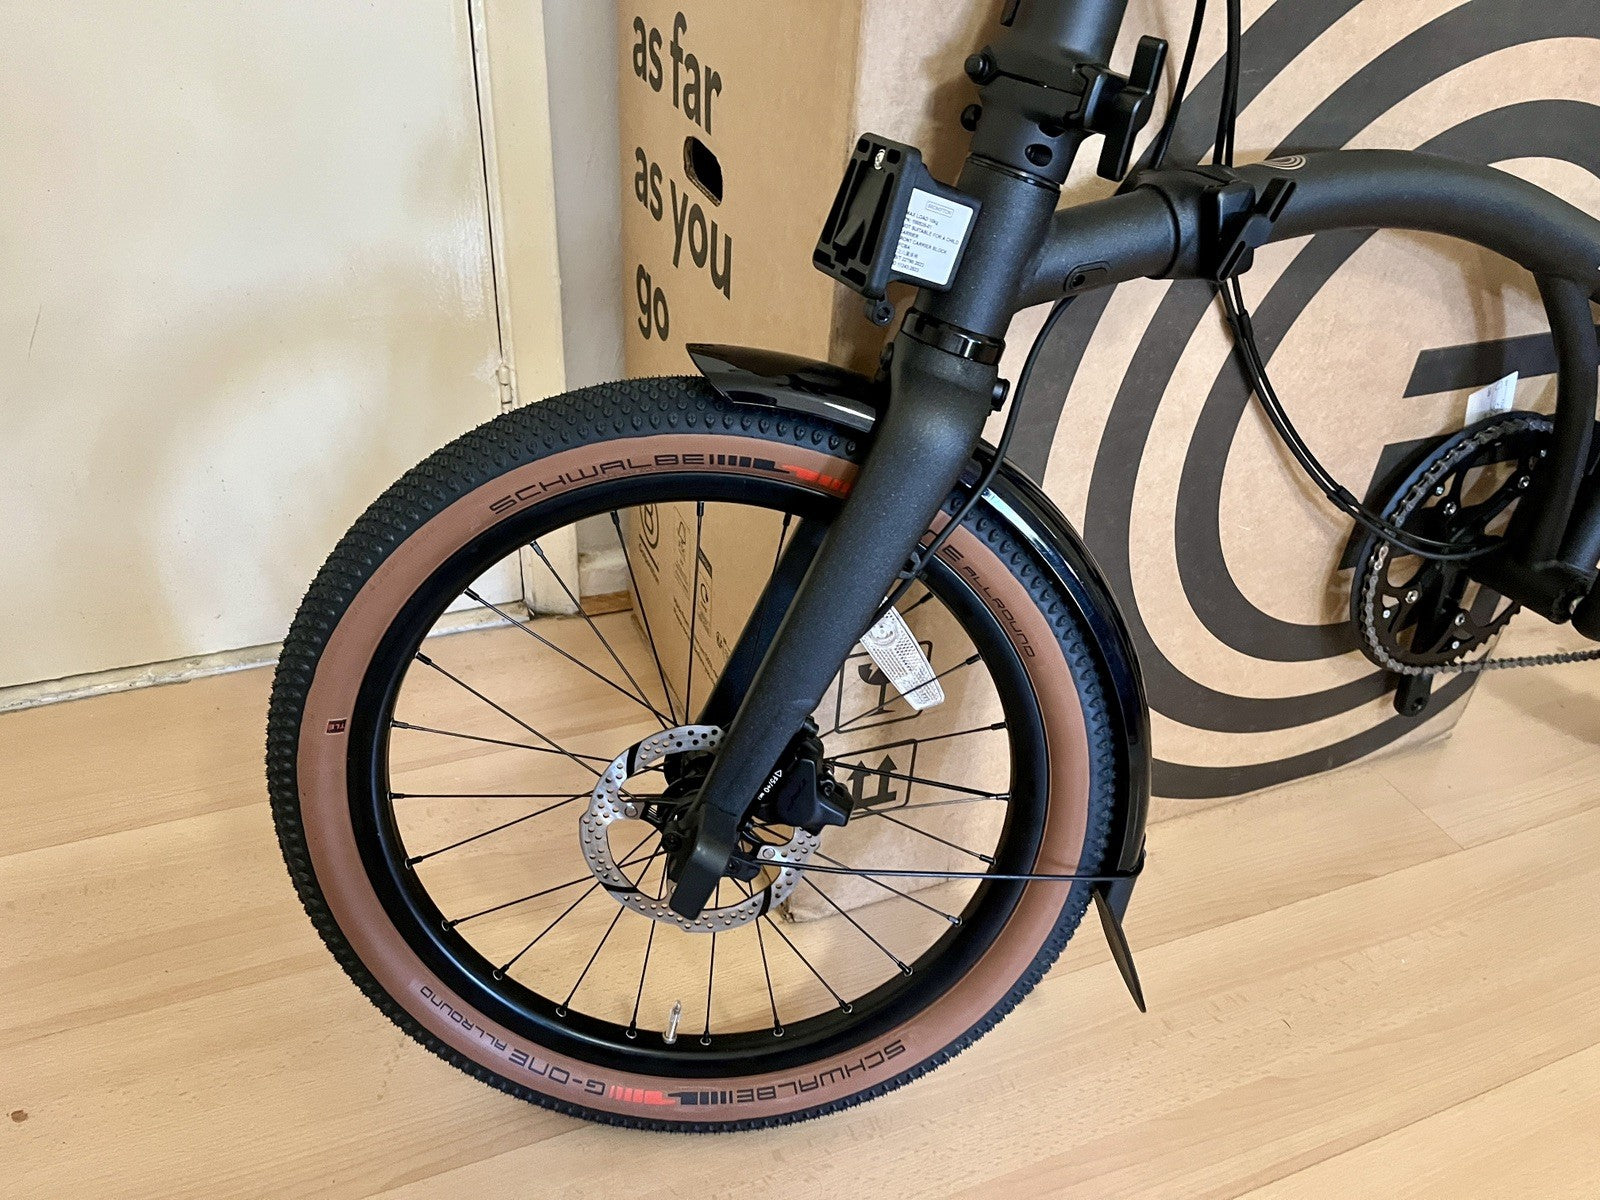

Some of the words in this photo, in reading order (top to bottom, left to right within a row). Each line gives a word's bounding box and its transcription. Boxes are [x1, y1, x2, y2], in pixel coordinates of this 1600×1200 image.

[633, 16, 663, 92] as
[670, 11, 722, 136] far
[635, 147, 663, 222] as
[670, 178, 732, 300] you
[902, 229, 918, 238] ARRIER
[637, 264, 669, 341] go
[489, 453, 706, 515] SCHWALBE
[963, 566, 1035, 657] ALLROUND
[420, 985, 508, 1051] ALLROUND
[508, 1049, 606, 1096] G-ONE
[736, 1039, 906, 1103] SCHWALBE
